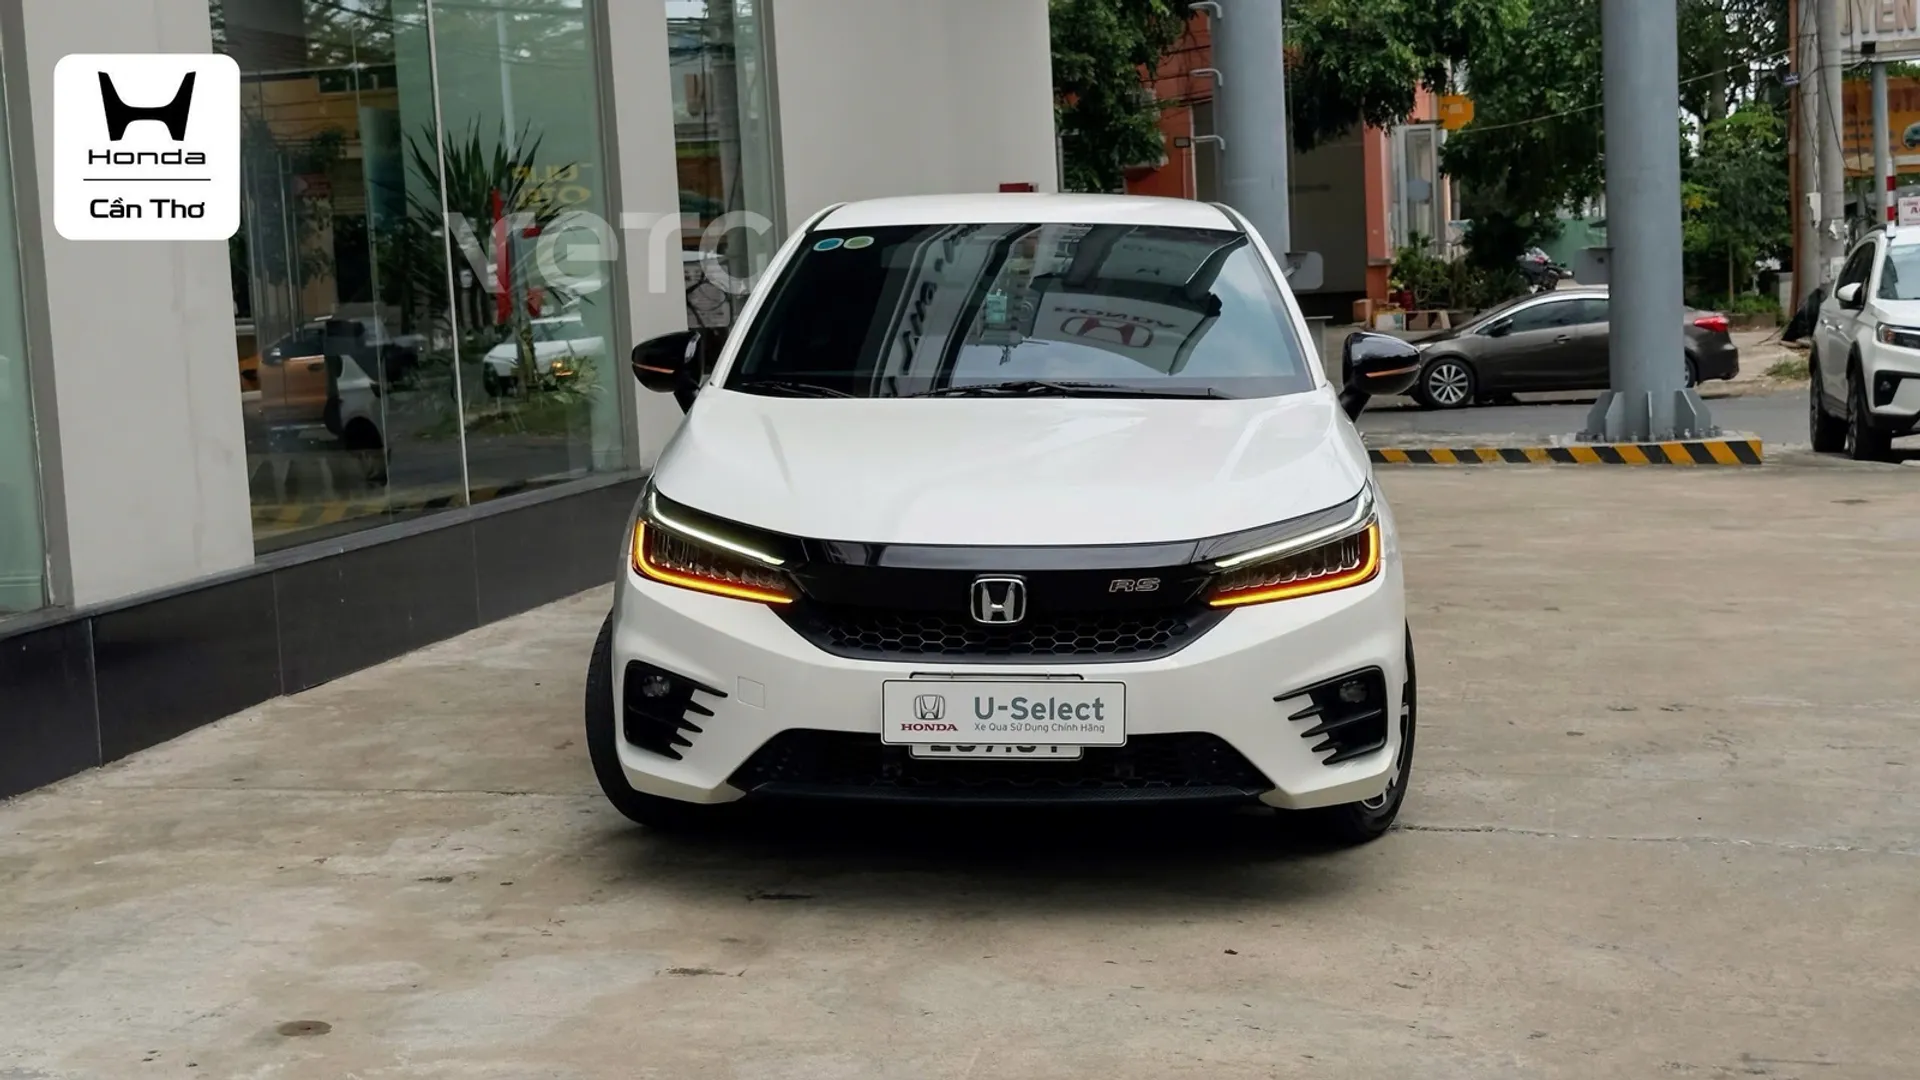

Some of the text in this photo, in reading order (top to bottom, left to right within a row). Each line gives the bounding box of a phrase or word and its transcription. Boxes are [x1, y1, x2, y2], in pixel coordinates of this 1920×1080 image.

[1108, 578, 1160, 592] RS
[974, 696, 1105, 721] U-Select
[900, 723, 959, 732] HONDA
[974, 722, 987, 732] Xe
[988, 722, 1008, 732] Qua
[1051, 722, 1079, 732] Chính
